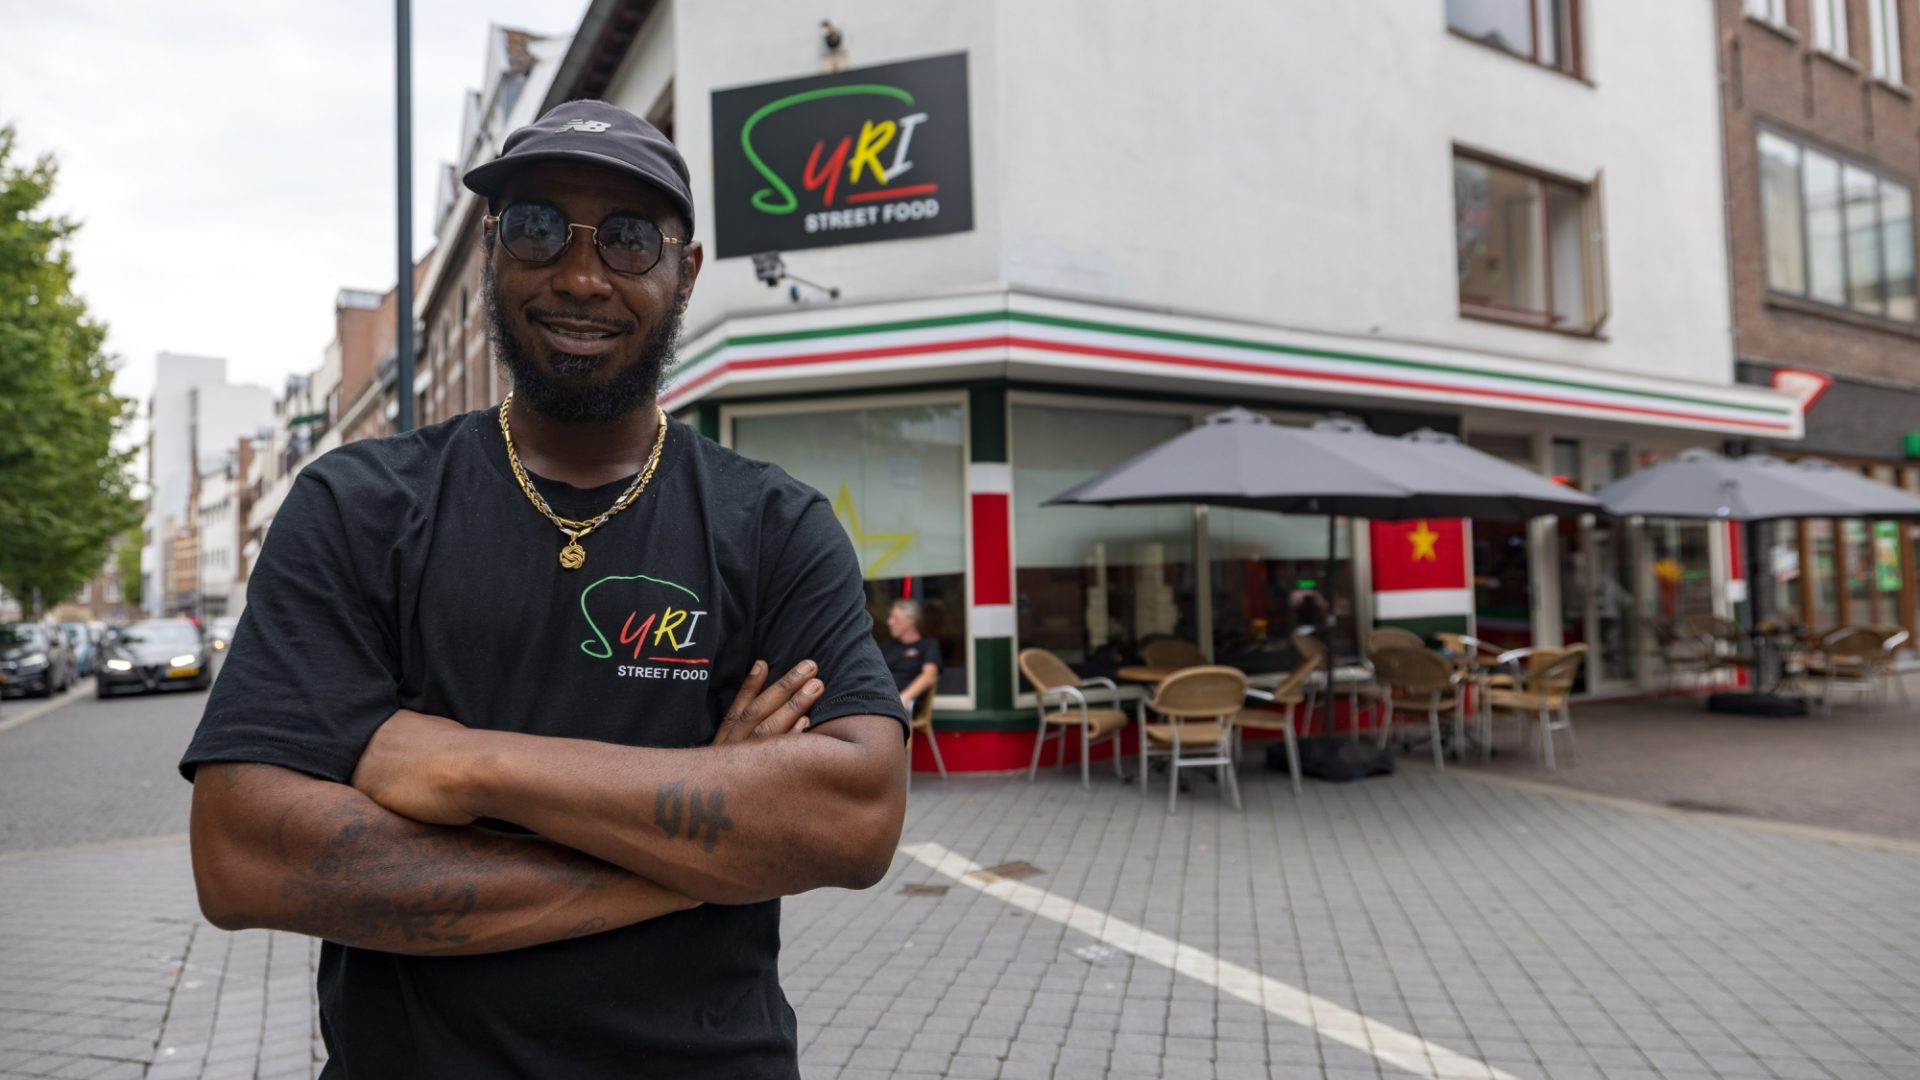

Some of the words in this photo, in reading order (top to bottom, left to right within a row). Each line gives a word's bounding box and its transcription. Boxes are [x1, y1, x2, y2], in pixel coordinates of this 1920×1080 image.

[804, 205, 880, 234] STREET
[882, 198, 940, 224] FOOD
[617, 665, 670, 680] STREET
[672, 669, 709, 681] FOOD
